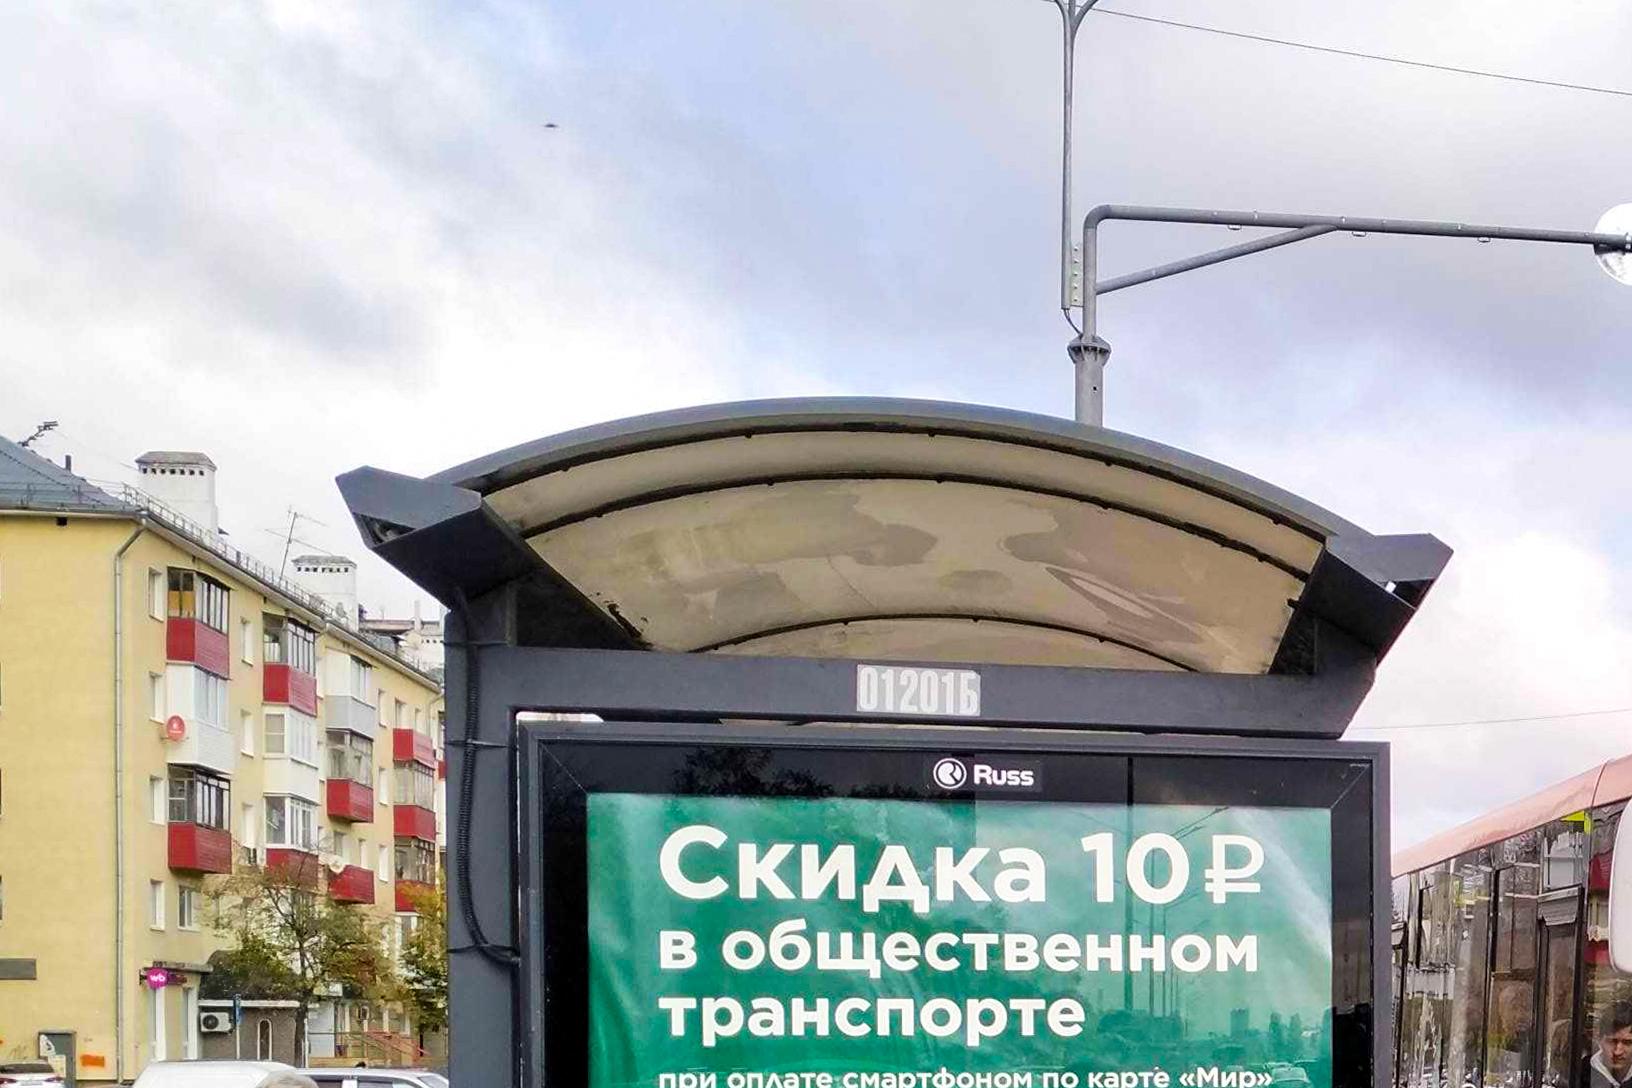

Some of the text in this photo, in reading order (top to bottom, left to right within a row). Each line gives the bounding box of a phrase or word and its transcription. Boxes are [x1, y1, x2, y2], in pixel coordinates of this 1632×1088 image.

[974, 764, 1034, 786] Russ
[659, 825, 1046, 913] Скидка
[659, 919, 1258, 978] в общественном
[150, 973, 165, 982] wb
[659, 996, 1085, 1047] транспорте
[1042, 1071, 1079, 1088] по
